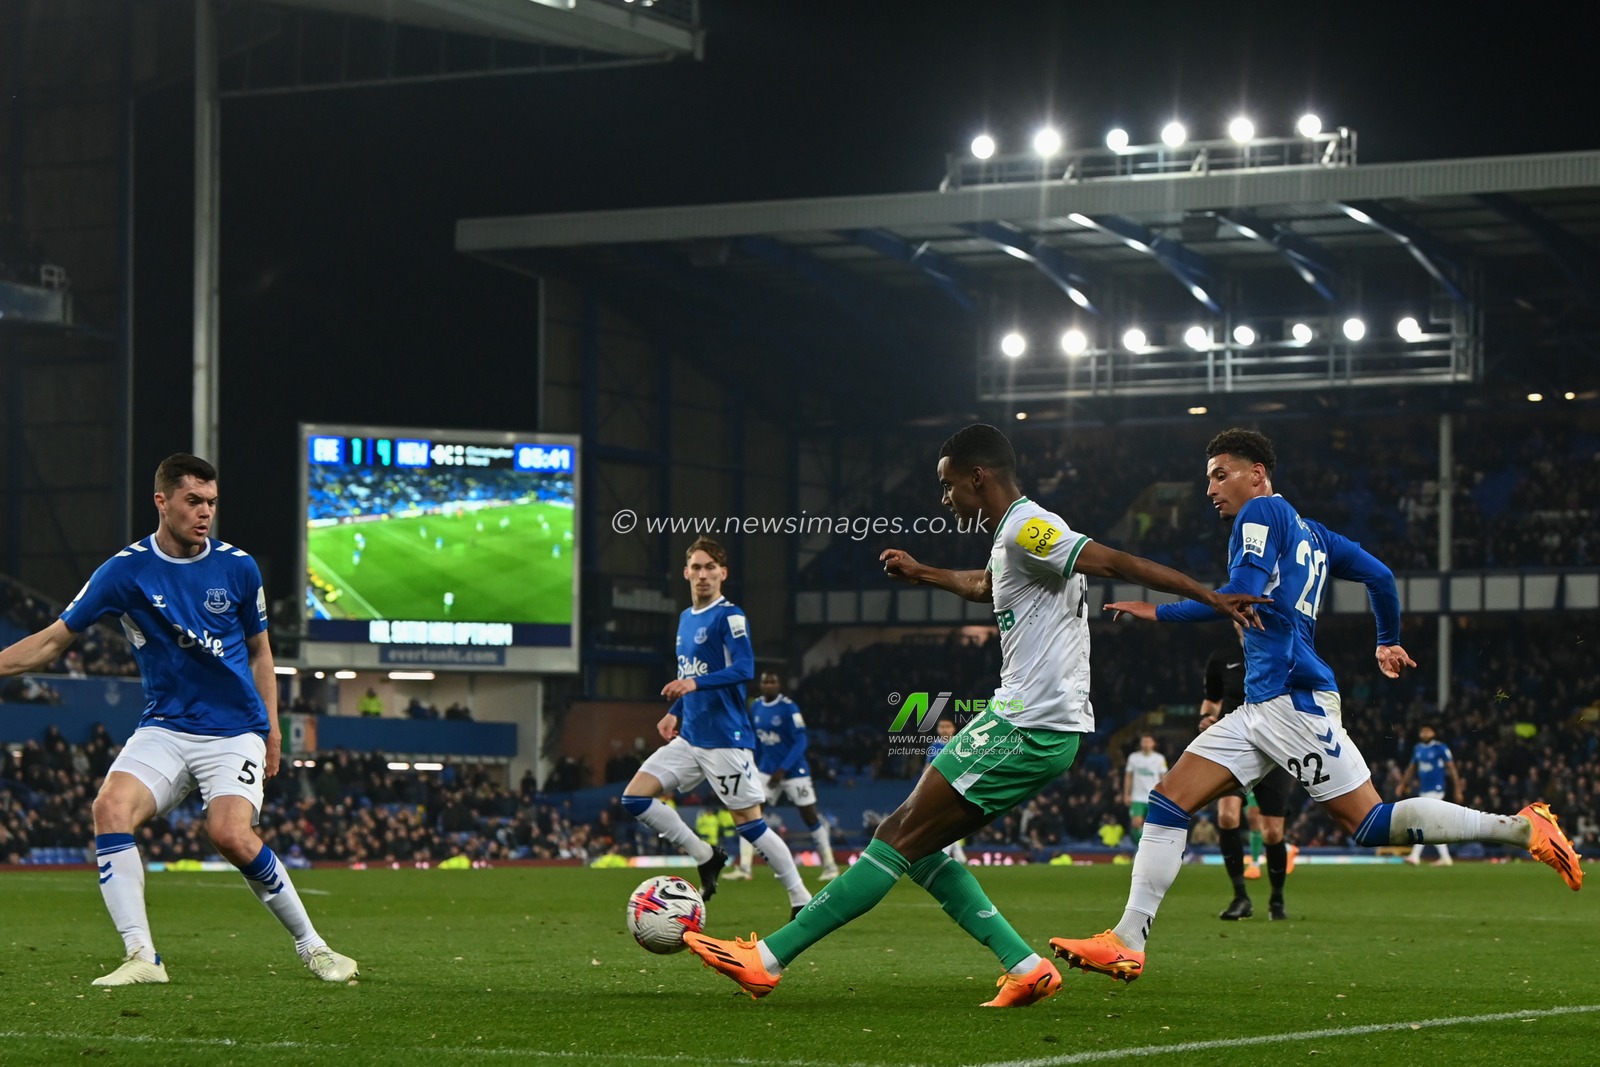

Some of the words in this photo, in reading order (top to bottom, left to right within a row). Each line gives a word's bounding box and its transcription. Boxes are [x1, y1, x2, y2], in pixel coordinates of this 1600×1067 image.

[1035, 527, 1056, 554] noon
[677, 655, 709, 680] Stake
[237, 759, 258, 785] 5
[1287, 752, 1330, 787] 22
[716, 773, 742, 797] 37
